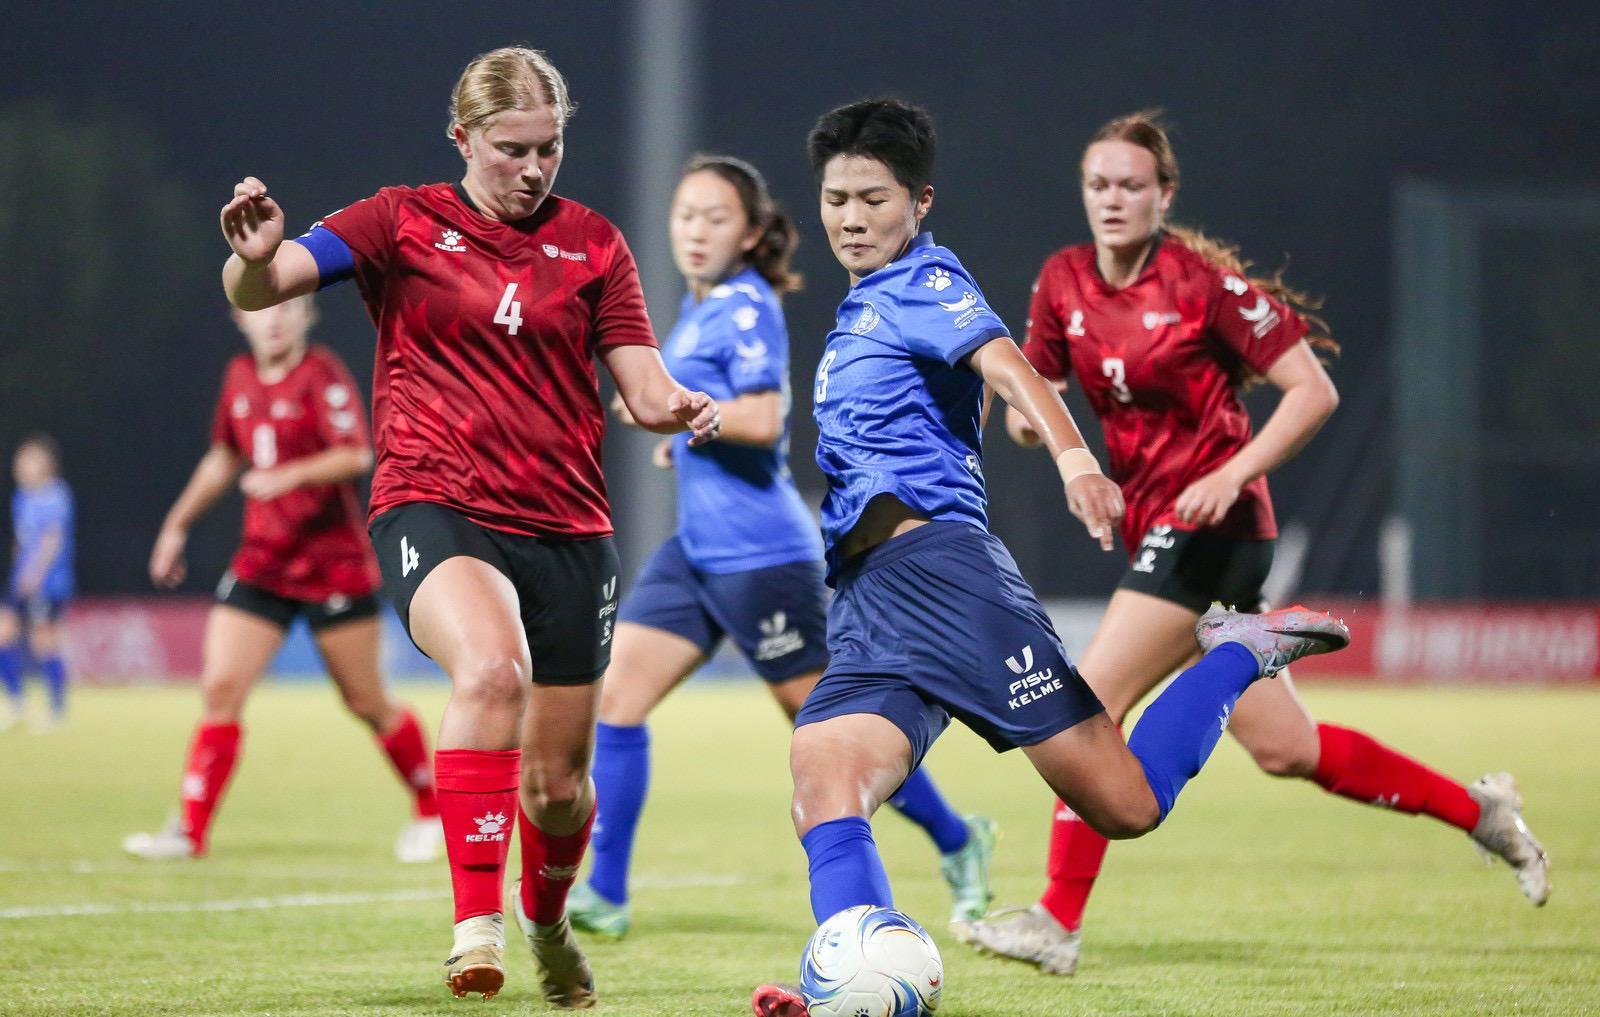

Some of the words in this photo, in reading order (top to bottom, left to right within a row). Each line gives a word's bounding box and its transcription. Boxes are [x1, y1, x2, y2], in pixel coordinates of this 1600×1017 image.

[493, 282, 523, 336] 4
[815, 350, 837, 404] 9
[400, 535, 420, 578] 4
[1007, 678, 1064, 710] KELME
[1008, 667, 1053, 695] FISU
[465, 832, 505, 843] KELME
